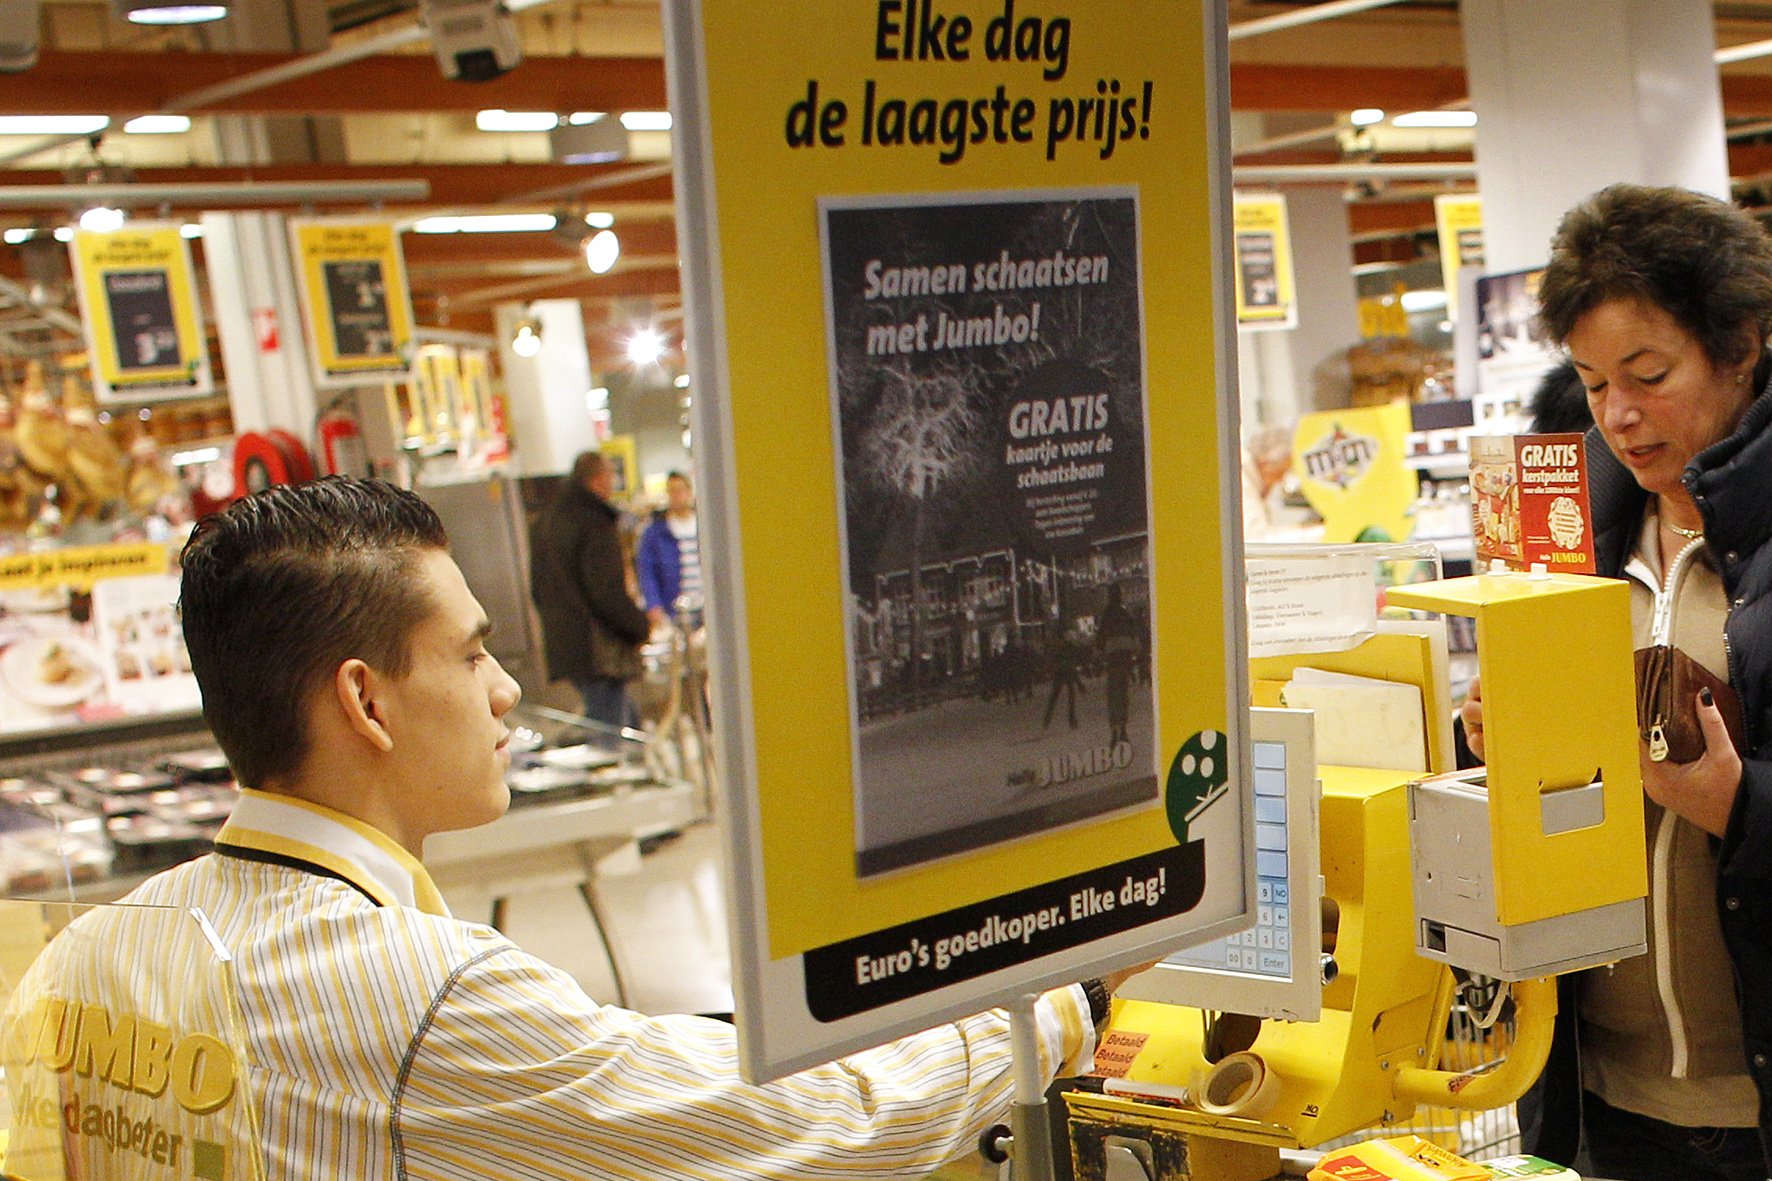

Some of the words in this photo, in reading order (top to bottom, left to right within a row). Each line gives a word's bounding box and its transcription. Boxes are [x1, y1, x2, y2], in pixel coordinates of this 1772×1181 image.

[875, 0, 971, 61] Elke
[985, 0, 1072, 81] dag
[784, 80, 846, 149] de
[861, 80, 1034, 164] laagste
[1047, 80, 1154, 162] prijs!
[863, 258, 967, 301] Samen
[973, 247, 1109, 296] schaatsen
[866, 318, 931, 357] met
[933, 303, 1041, 352] Jumbo!
[1008, 392, 1109, 440] GRATIS
[1006, 439, 1059, 467] kaartje
[1061, 439, 1095, 458] voor
[1096, 432, 1114, 454] de
[1521, 444, 1578, 467] GRATIS
[1017, 461, 1105, 489] schaatsbaan
[1522, 468, 1579, 486] kerstpakket
[1551, 552, 1586, 563] JUMBO
[1036, 740, 1135, 789] JUMBO
[855, 940, 933, 985] Euro's
[933, 908, 1067, 970] goedkoper.
[1070, 884, 1116, 924] Elke
[1118, 867, 1168, 917] dag!
[1263, 957, 1286, 969] Enter
[1096, 1049, 1135, 1064] Betaald
[1106, 1033, 1146, 1048] Betaald
